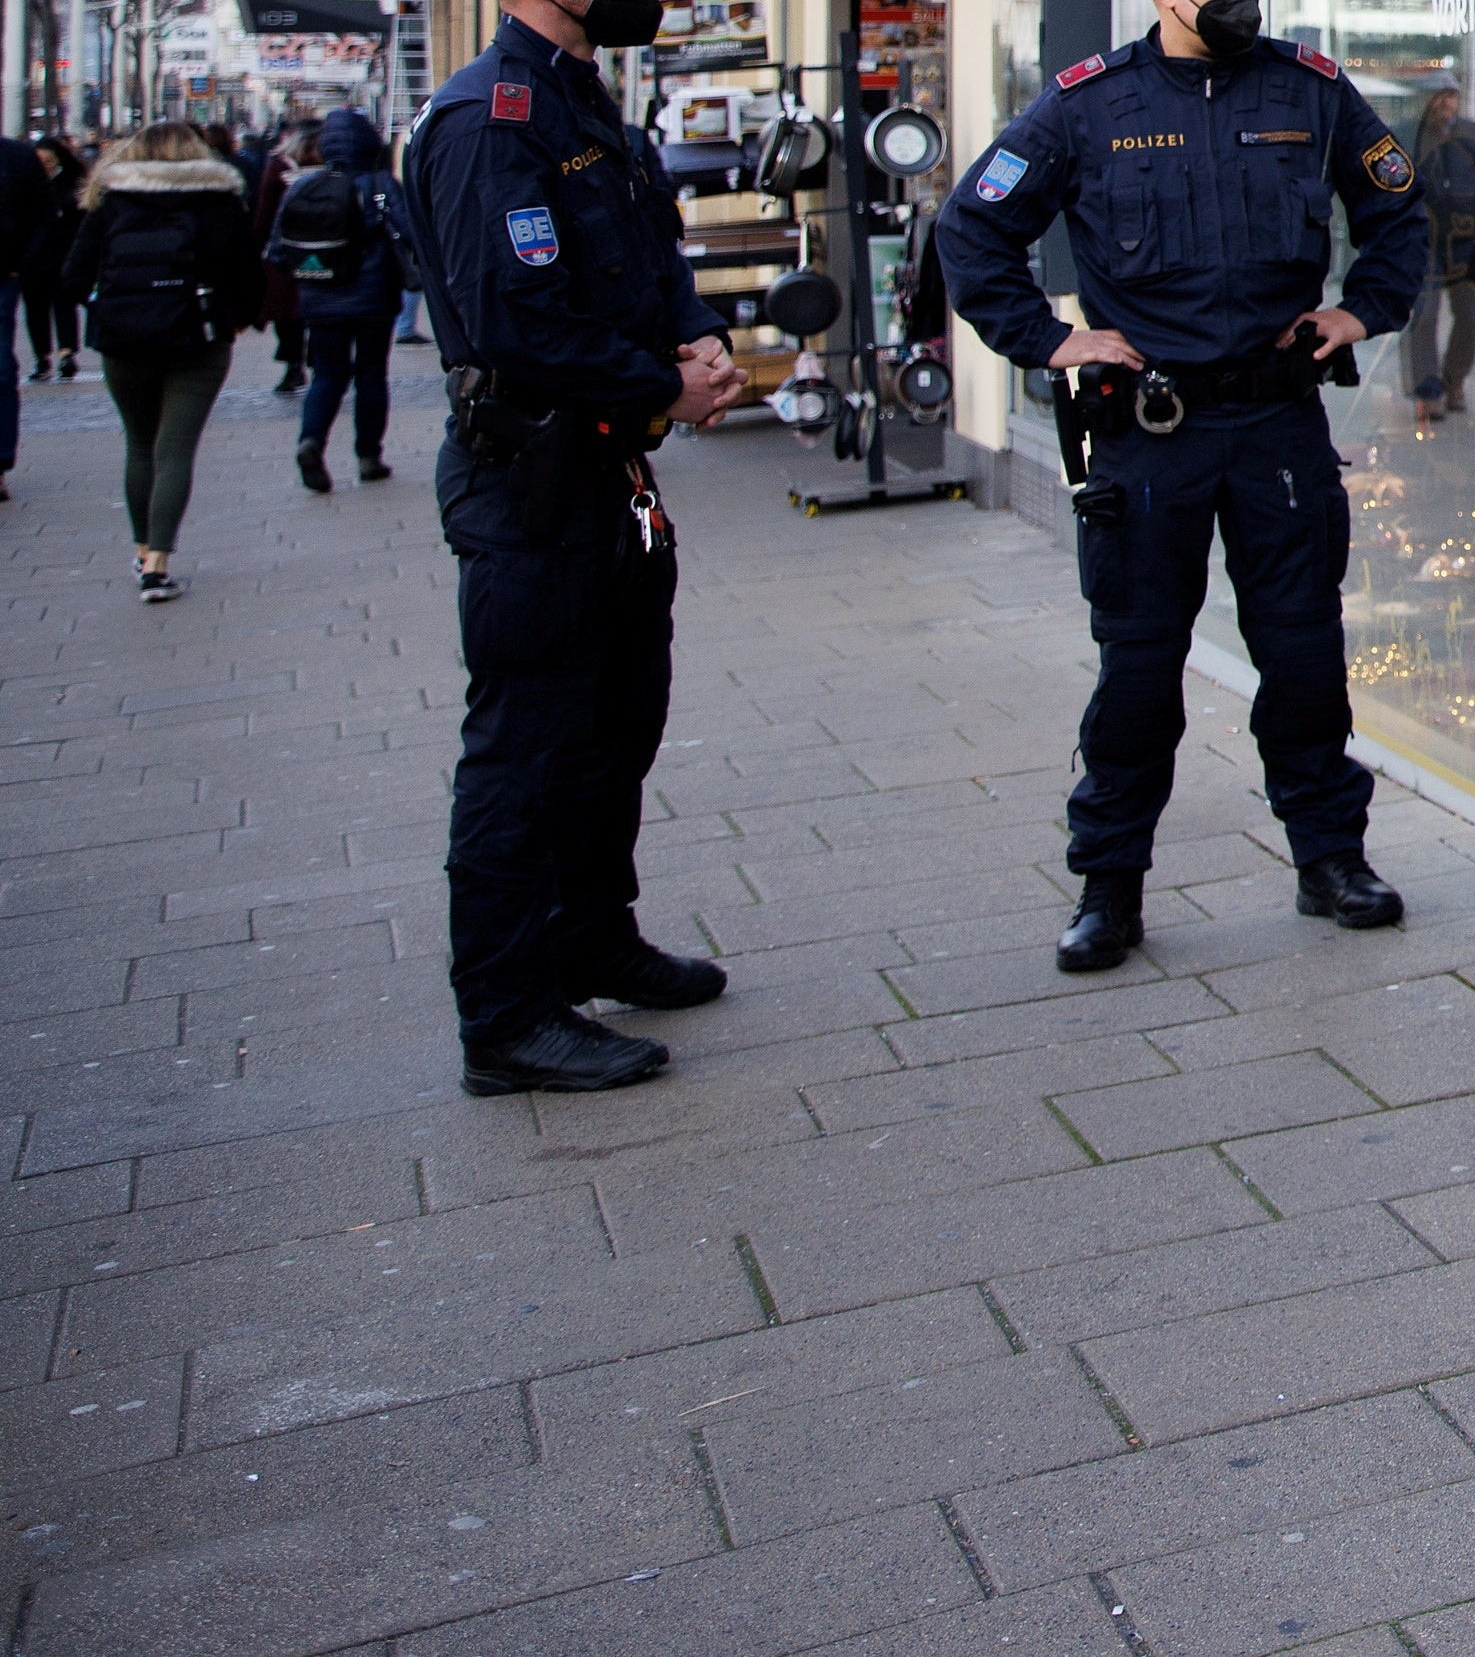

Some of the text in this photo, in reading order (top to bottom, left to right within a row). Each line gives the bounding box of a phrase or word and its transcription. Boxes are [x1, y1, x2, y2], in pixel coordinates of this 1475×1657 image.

[1112, 133, 1186, 152] POLIZEI
[561, 145, 604, 176] POLIZE
[986, 157, 1023, 187] BE
[511, 216, 553, 244] BE
